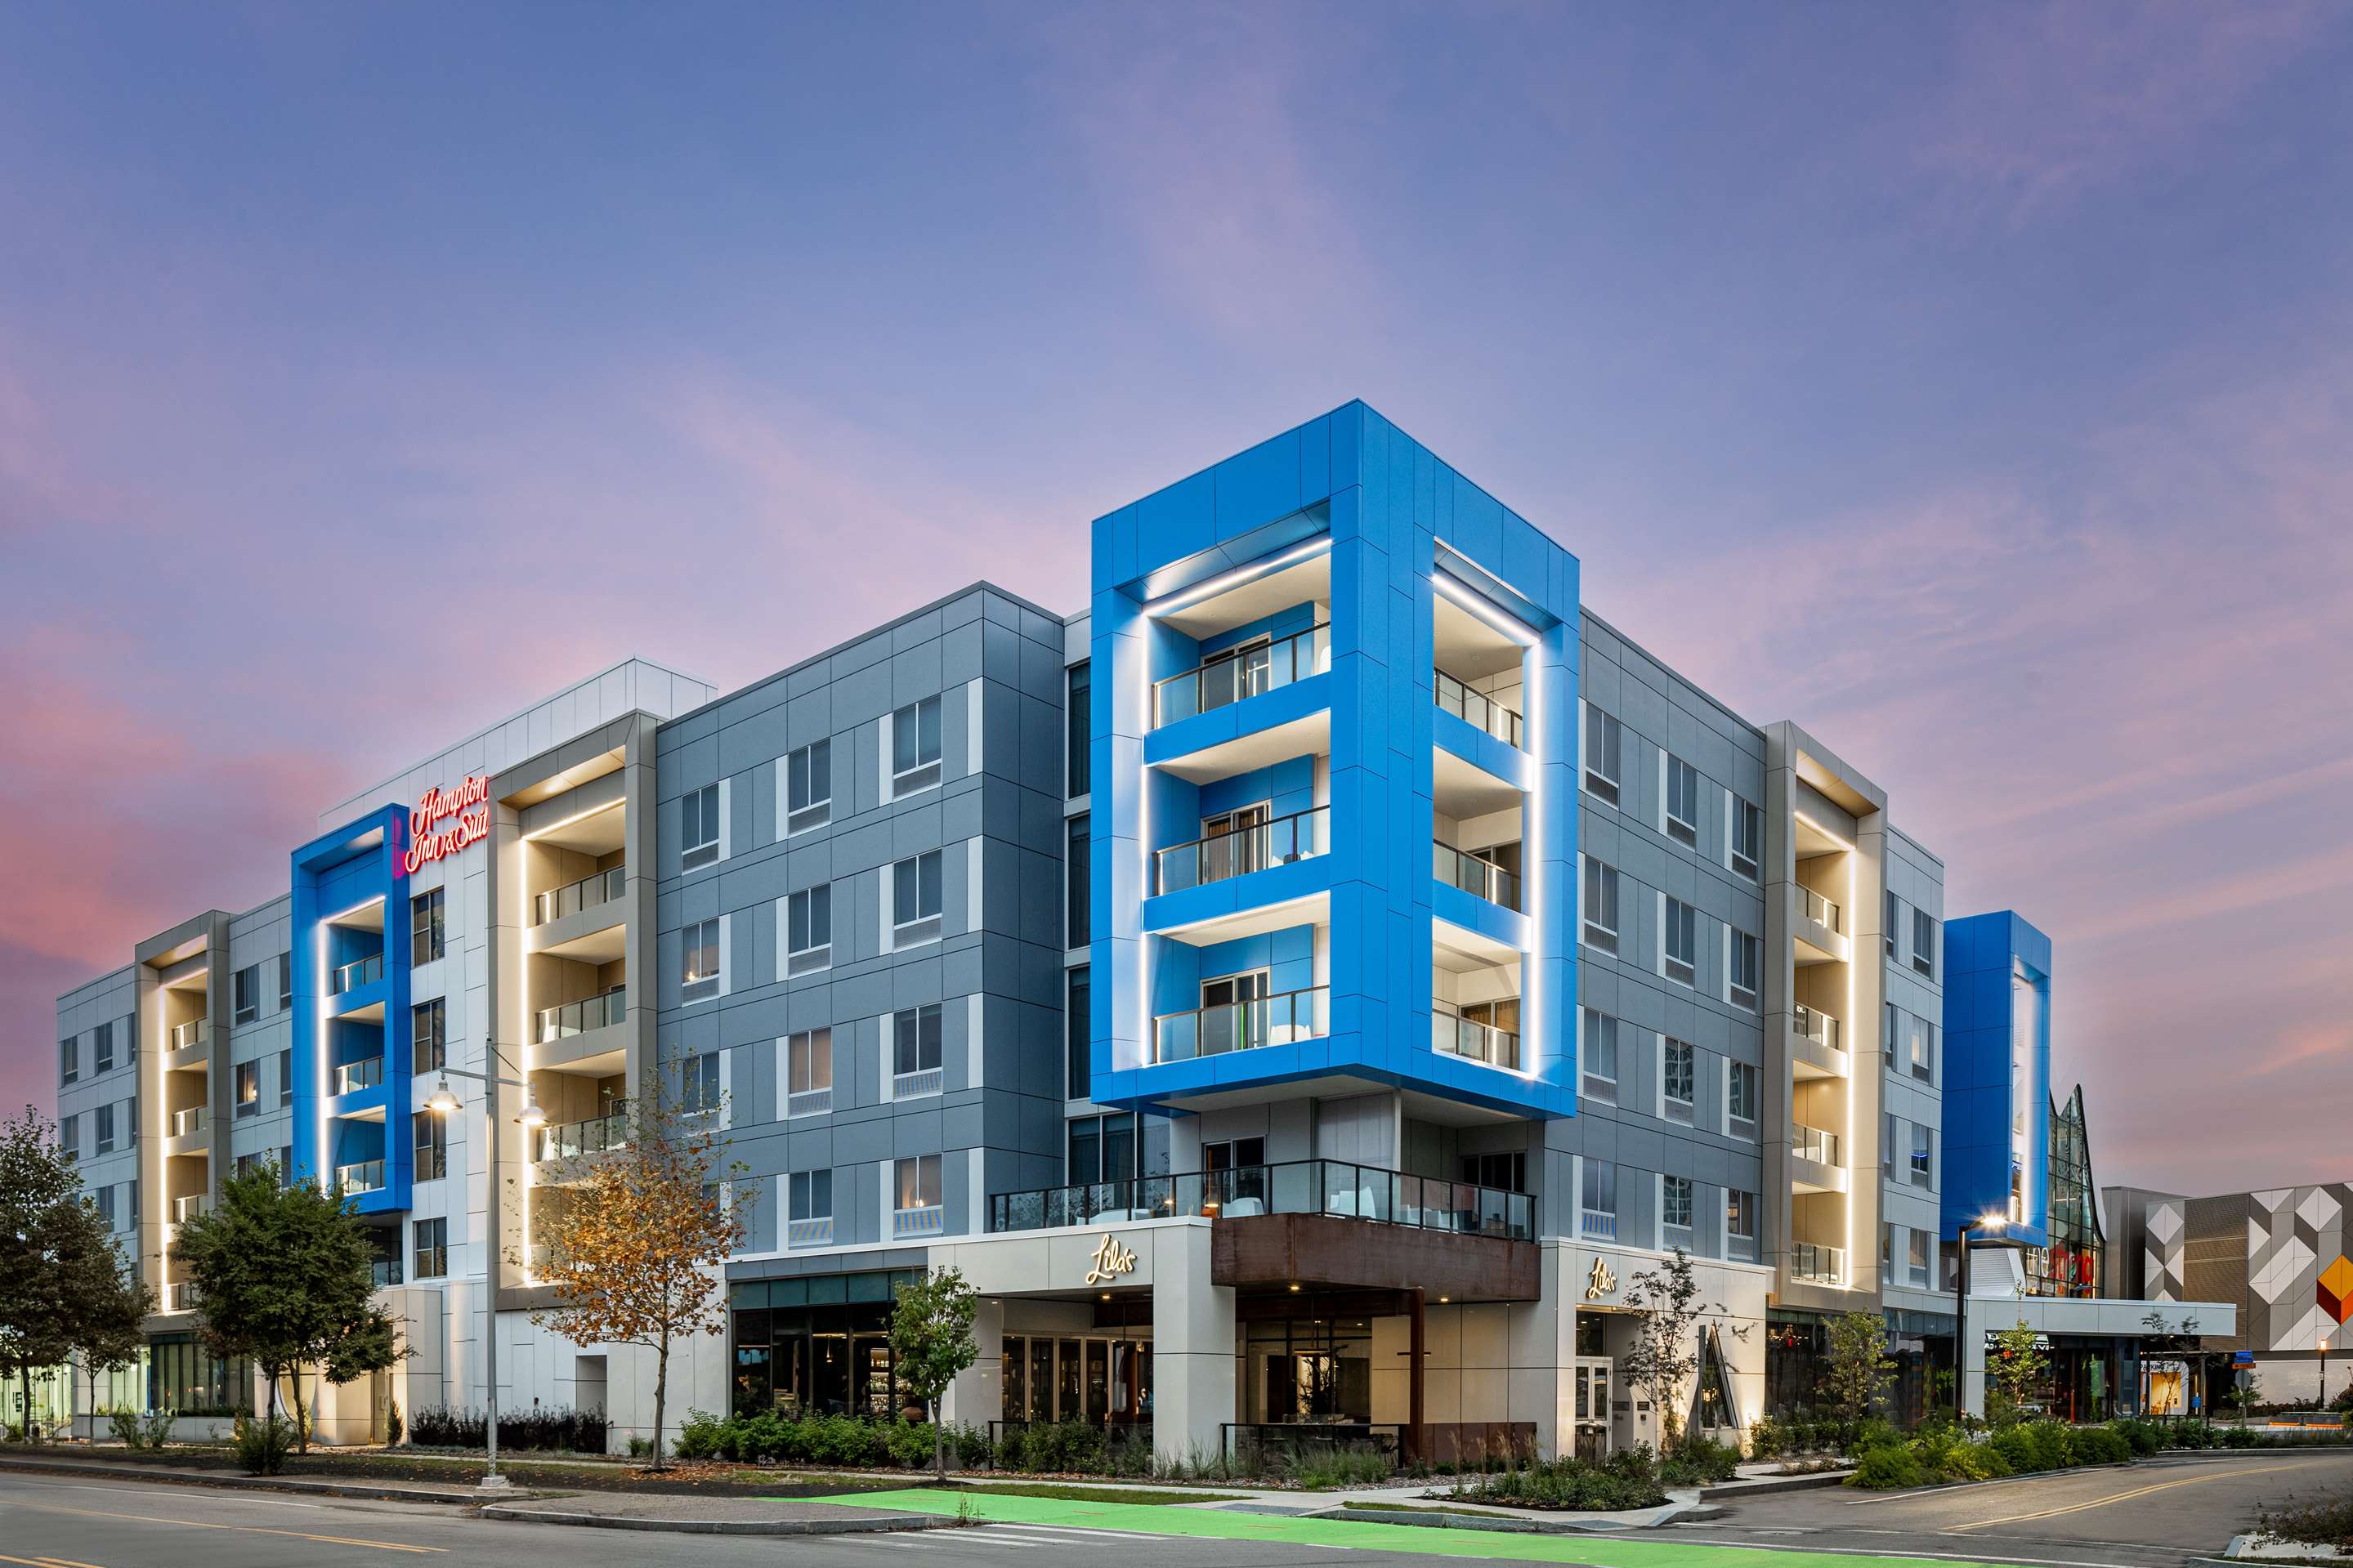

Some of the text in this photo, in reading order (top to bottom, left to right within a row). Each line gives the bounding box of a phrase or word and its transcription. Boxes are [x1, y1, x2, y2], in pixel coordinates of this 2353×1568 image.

[410, 775, 488, 838] Hampton
[405, 833, 447, 873] Inn
[445, 829, 459, 852] &
[1085, 1233, 1137, 1285] Lila's
[1586, 1257, 1617, 1299] Lila's
